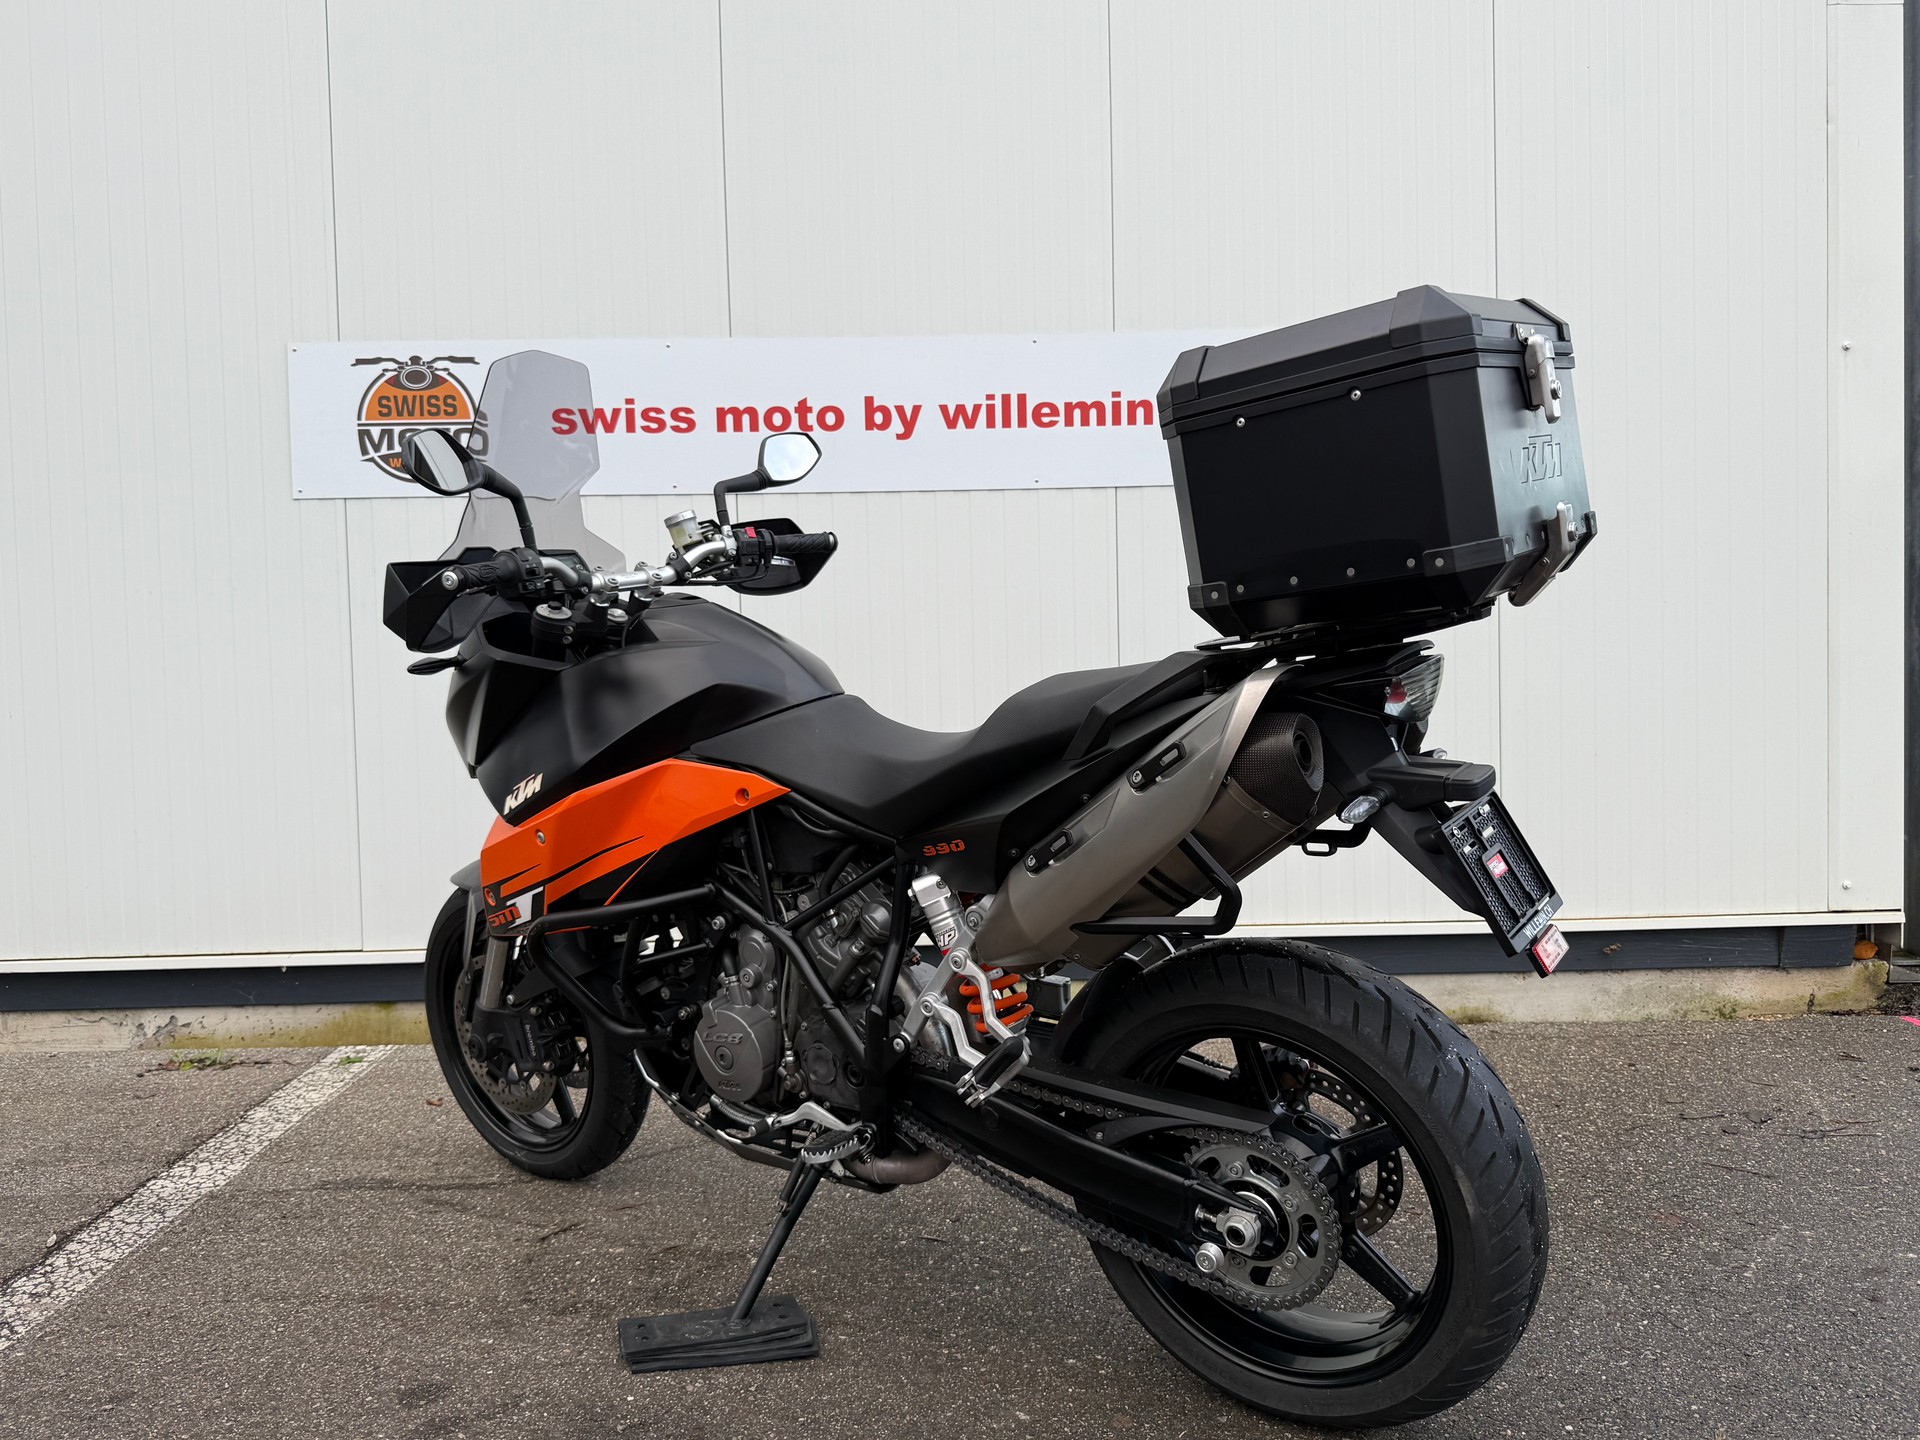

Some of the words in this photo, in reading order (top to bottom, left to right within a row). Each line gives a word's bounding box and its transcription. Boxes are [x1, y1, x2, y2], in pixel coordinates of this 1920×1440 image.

[377, 394, 458, 418] SWISS
[551, 397, 697, 435] swiss
[715, 397, 845, 433] moto
[864, 395, 923, 441] by
[938, 391, 1154, 430] willemin
[357, 427, 489, 457] MO
[1520, 433, 1563, 485] KTM
[503, 772, 544, 816] KTM
[922, 839, 966, 857] 990
[703, 1032, 744, 1045] LC8
